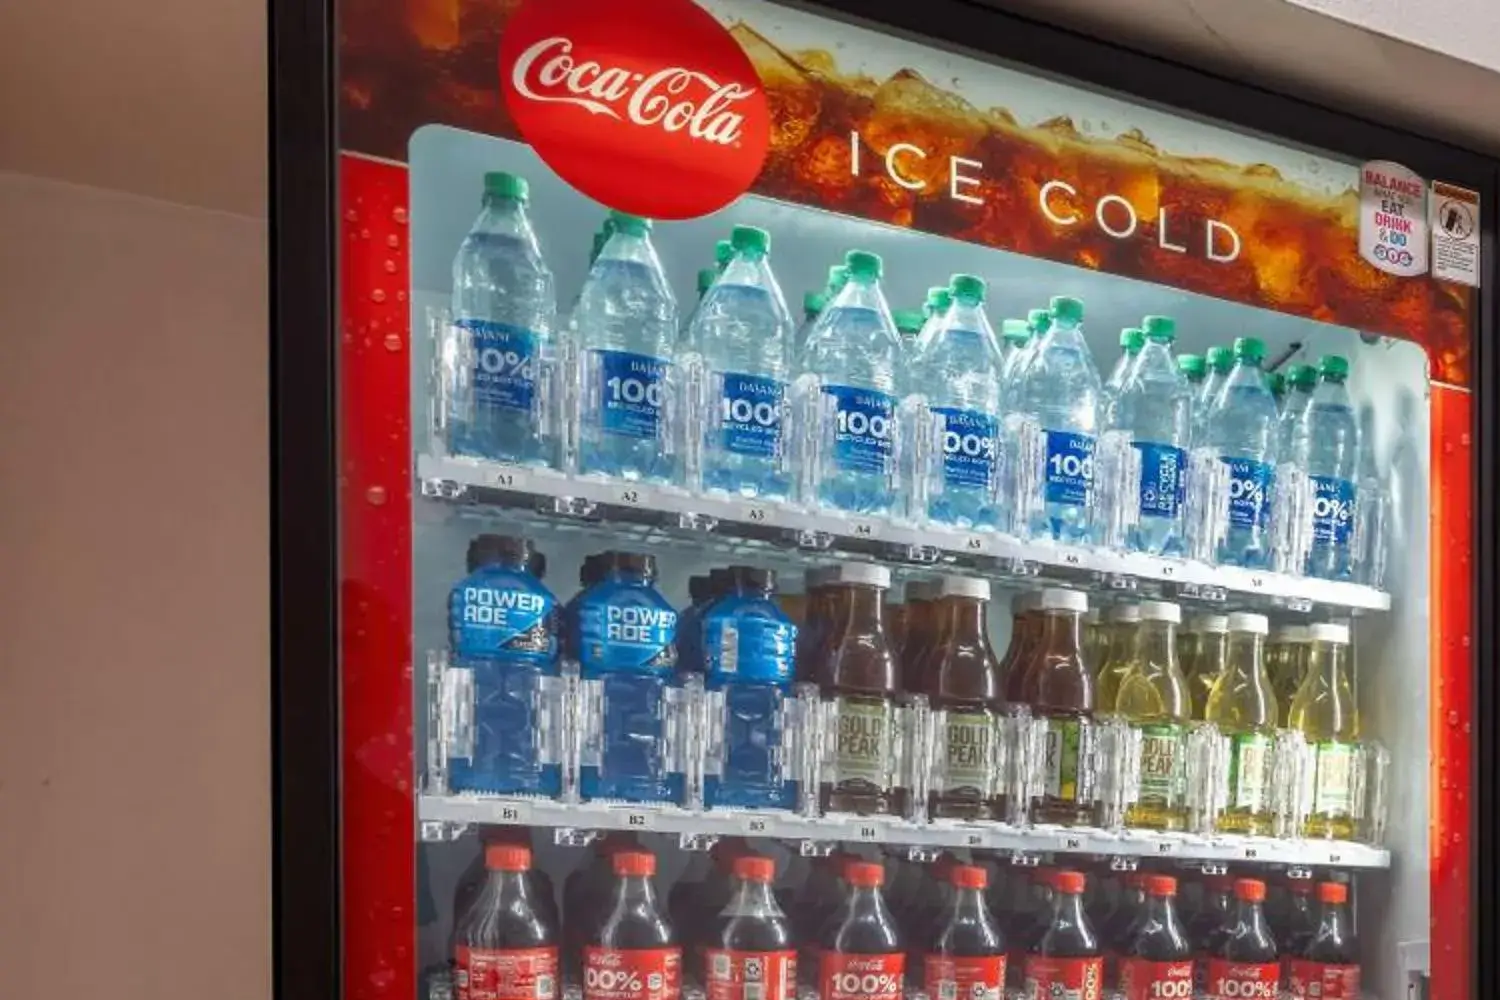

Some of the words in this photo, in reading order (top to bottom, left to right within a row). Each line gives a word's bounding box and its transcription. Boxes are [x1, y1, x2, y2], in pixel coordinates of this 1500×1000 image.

[512, 36, 757, 145] Coca-Cola
[1364, 169, 1421, 198] BALANCE
[850, 130, 984, 205] ICE
[1038, 179, 1242, 263] COLD
[1381, 199, 1405, 216] EAT
[1375, 211, 1413, 234] DRINK
[473, 347, 536, 381] 0%
[607, 376, 662, 407] 100
[836, 410, 890, 439] 100
[943, 432, 996, 460] 00%
[1050, 453, 1093, 480] 100
[1229, 479, 1263, 501] 0%
[749, 508, 766, 521] A3
[1314, 497, 1348, 521] 0%
[463, 587, 545, 613] POWER
[463, 603, 508, 626] ADE
[606, 605, 678, 629] POWER
[606, 622, 652, 643] ADE
[838, 715, 881, 738] GOLD
[949, 724, 989, 745] GOLD
[838, 736, 880, 757] PEAK
[586, 966, 643, 993] 00%
[831, 971, 897, 994] 100%
[1216, 978, 1271, 998] 100%
